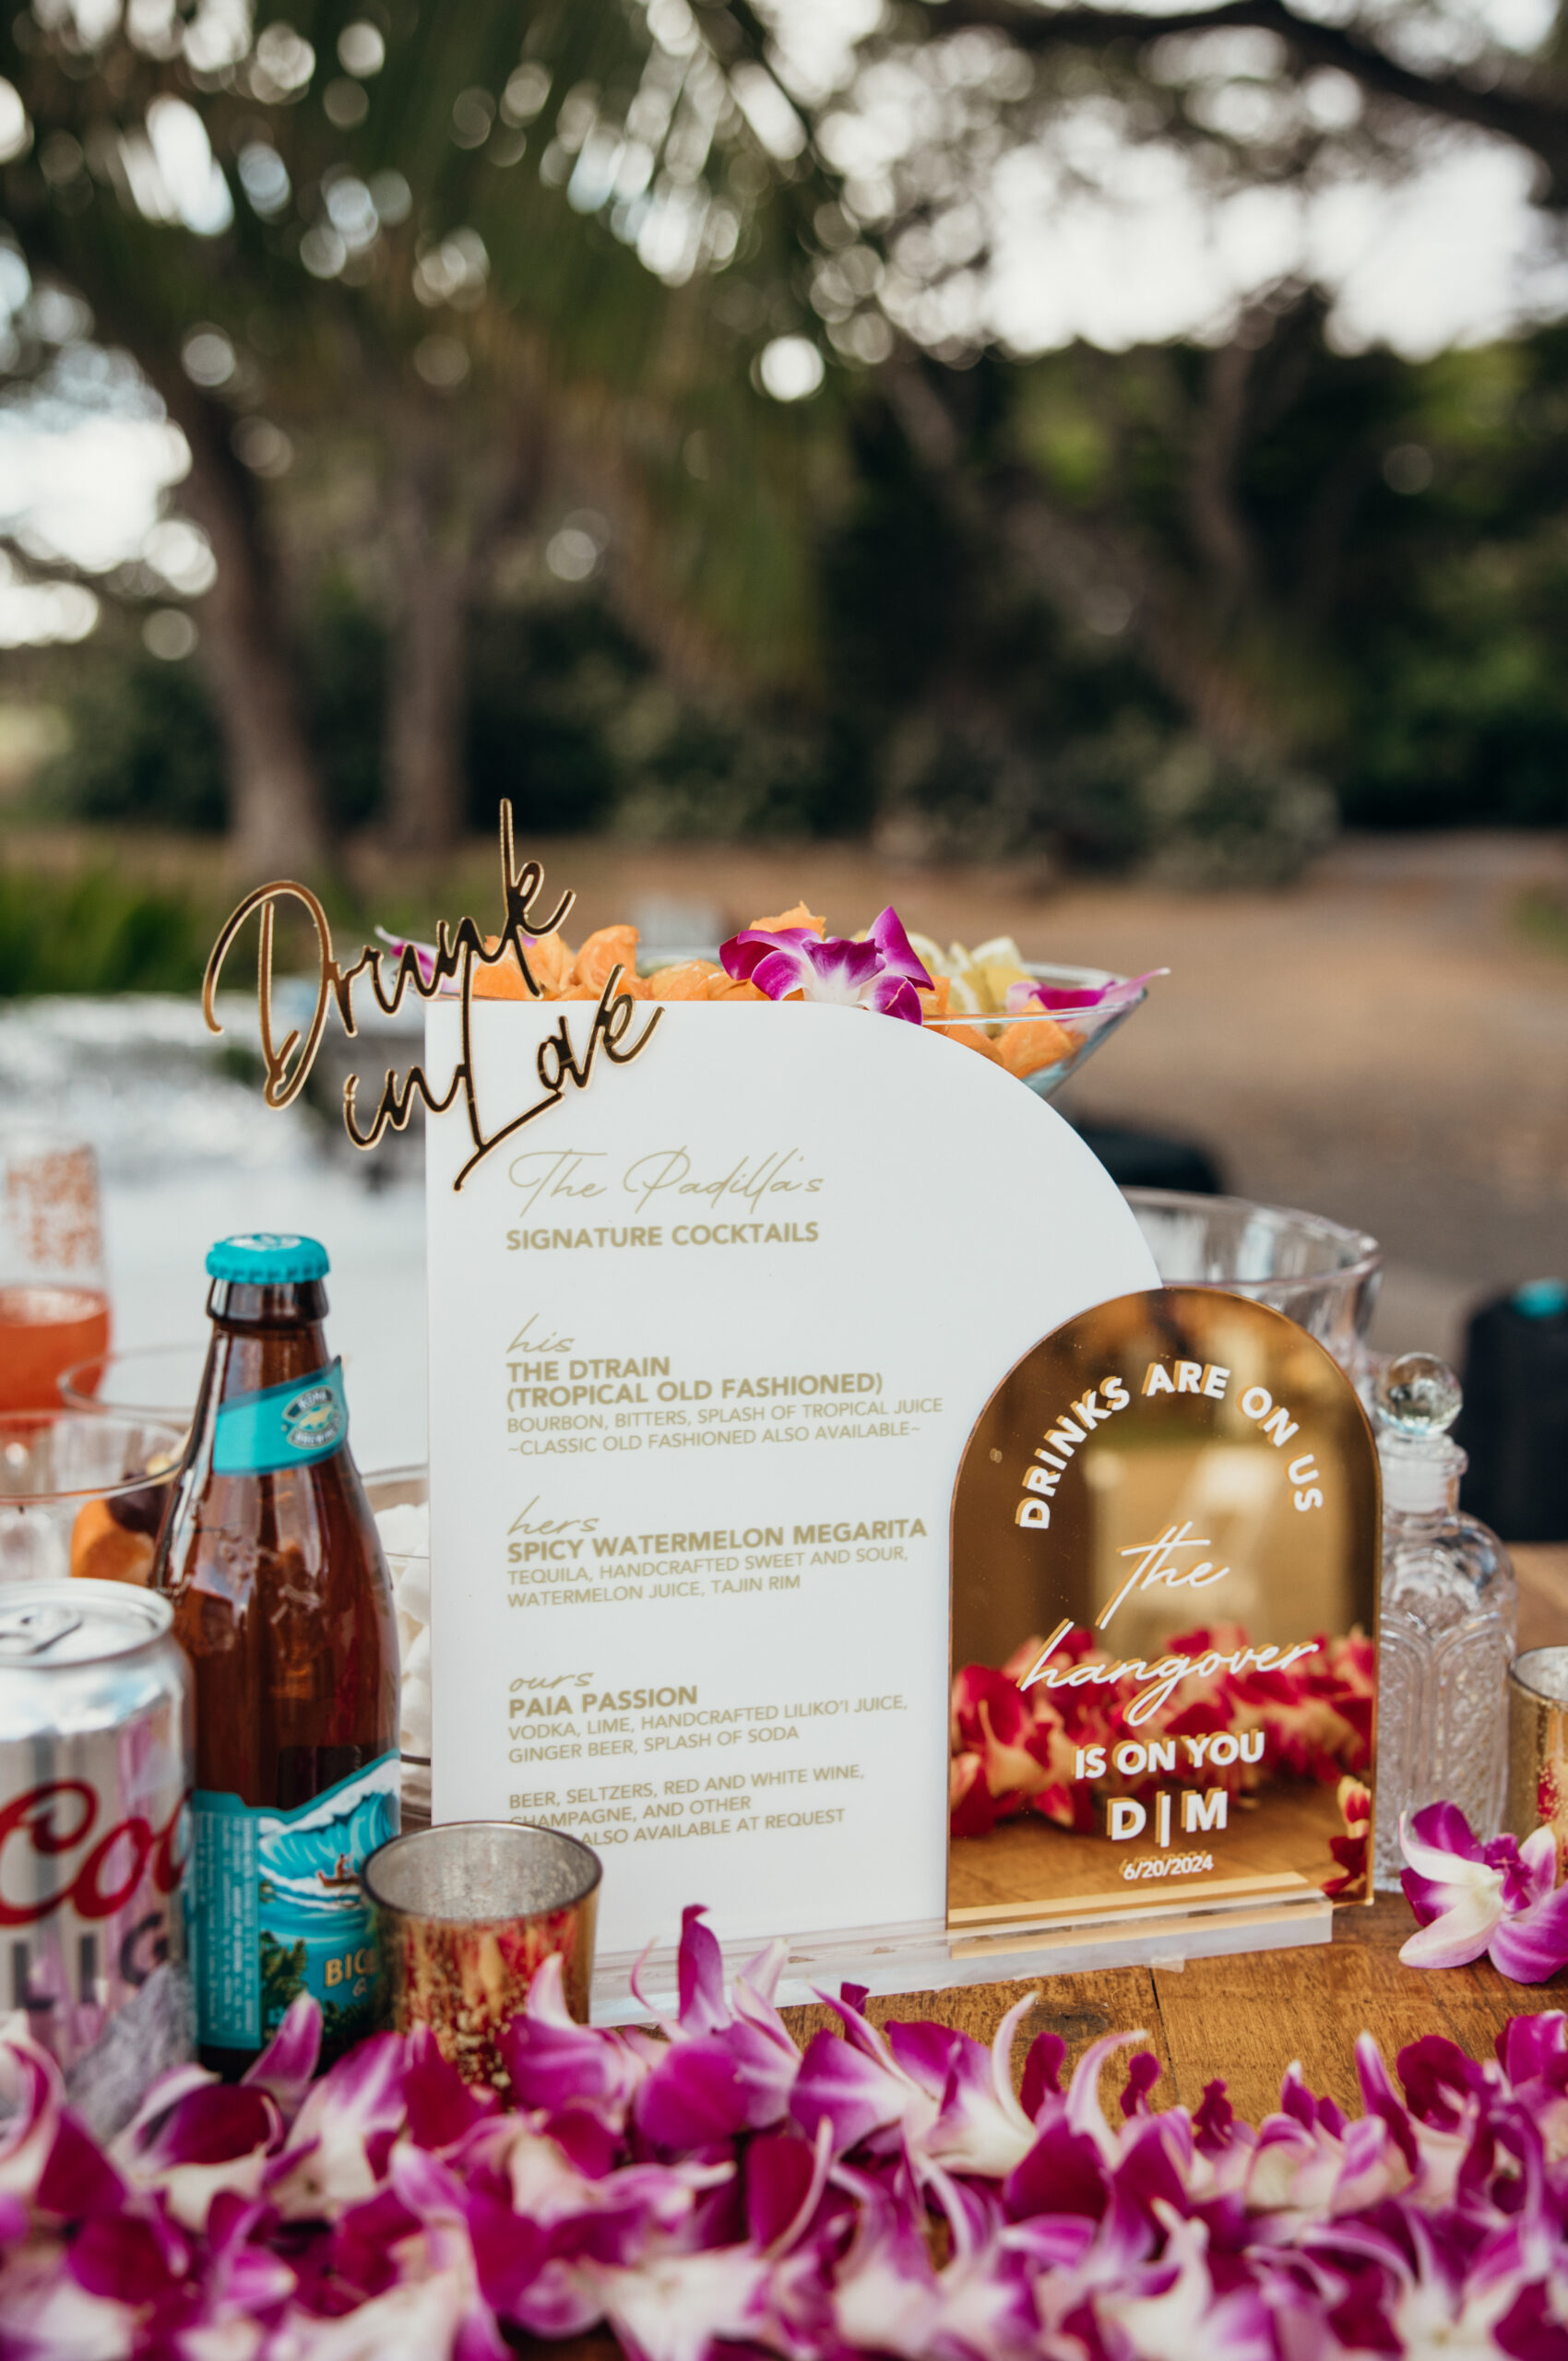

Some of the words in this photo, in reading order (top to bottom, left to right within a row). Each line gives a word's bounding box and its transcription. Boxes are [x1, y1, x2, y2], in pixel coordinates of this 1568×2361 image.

[202, 798, 576, 1109] Drunk
[343, 1066, 466, 1150] in
[454, 942, 666, 1192] Love
[509, 1149, 607, 1216] The
[623, 1145, 823, 1214] Padilla's
[506, 1226, 662, 1251] SIGNATURE
[671, 1221, 819, 1246] COCKTAILS
[506, 1313, 576, 1353] his
[505, 1361, 560, 1382] THE
[568, 1358, 670, 1380] DTRAIN
[507, 1384, 649, 1412] (TROPICAL
[657, 1380, 713, 1402] OLD
[721, 1372, 883, 1399] FASHIONED)
[507, 1415, 608, 1433] BOURBON,
[615, 1410, 692, 1428] BITTERS,
[697, 1407, 765, 1424] SPLASH
[771, 1405, 797, 1420] OF
[802, 1402, 888, 1417] TROPICAL
[893, 1398, 942, 1414] JUICE
[602, 1435, 642, 1452] OLD
[648, 1430, 756, 1448] FASHIONED
[762, 1426, 809, 1442] ALSO
[1019, 1378, 1130, 1529] DRINKS
[1146, 1361, 1230, 1399] ARE
[1241, 1386, 1300, 1447] ON
[1288, 1453, 1323, 1512] US
[507, 1496, 599, 1535] hers
[507, 1539, 584, 1563] SPICY
[591, 1527, 785, 1560] WATERMELON
[793, 1518, 928, 1545] MEGARITA
[507, 1567, 592, 1585] TEQUILA,
[600, 1557, 740, 1579] HANDCRAFTED
[745, 1552, 804, 1571] SWEET
[810, 1549, 850, 1564] AND
[856, 1547, 908, 1562] SOUR,
[1099, 1521, 1229, 1630] the
[507, 1586, 642, 1608] WATERMELON
[649, 1582, 704, 1598] JUICE,
[711, 1579, 763, 1594] TAJIN
[768, 1574, 801, 1589] RIM
[509, 1673, 594, 1692] ours
[1020, 1621, 1319, 1726] hangover
[509, 1695, 574, 1719] PAIA
[581, 1685, 697, 1714] PASSION
[509, 1723, 580, 1741] VODKA,
[588, 1717, 635, 1734] LIME,
[642, 1706, 778, 1730] HANDCRAFTED
[855, 1695, 908, 1713] JUICE,
[509, 1743, 583, 1763] GINGER
[588, 1739, 637, 1756] BEER,
[644, 1734, 711, 1752] SPLASH
[717, 1730, 742, 1746] OF
[747, 1726, 799, 1743] SODA
[1075, 1747, 1107, 1779] IS
[1116, 1740, 1176, 1774] ON
[1184, 1732, 1265, 1768] YOU
[509, 1792, 560, 1809] BEER,
[566, 1782, 657, 1804] SELTZERS,
[664, 1778, 700, 1795] RED
[705, 1775, 745, 1791] AND
[751, 1769, 809, 1787] WHITE
[814, 1764, 865, 1781] WINE,
[581, 1830, 629, 1846] ALSO
[633, 1819, 731, 1840] AVAILABLE
[736, 1816, 760, 1833] AT
[765, 1809, 845, 1830] REQUEST
[643, 1802, 683, 1820] AND
[689, 1797, 752, 1815] OTHER
[1123, 1854, 1214, 1881] 6/20/2024
